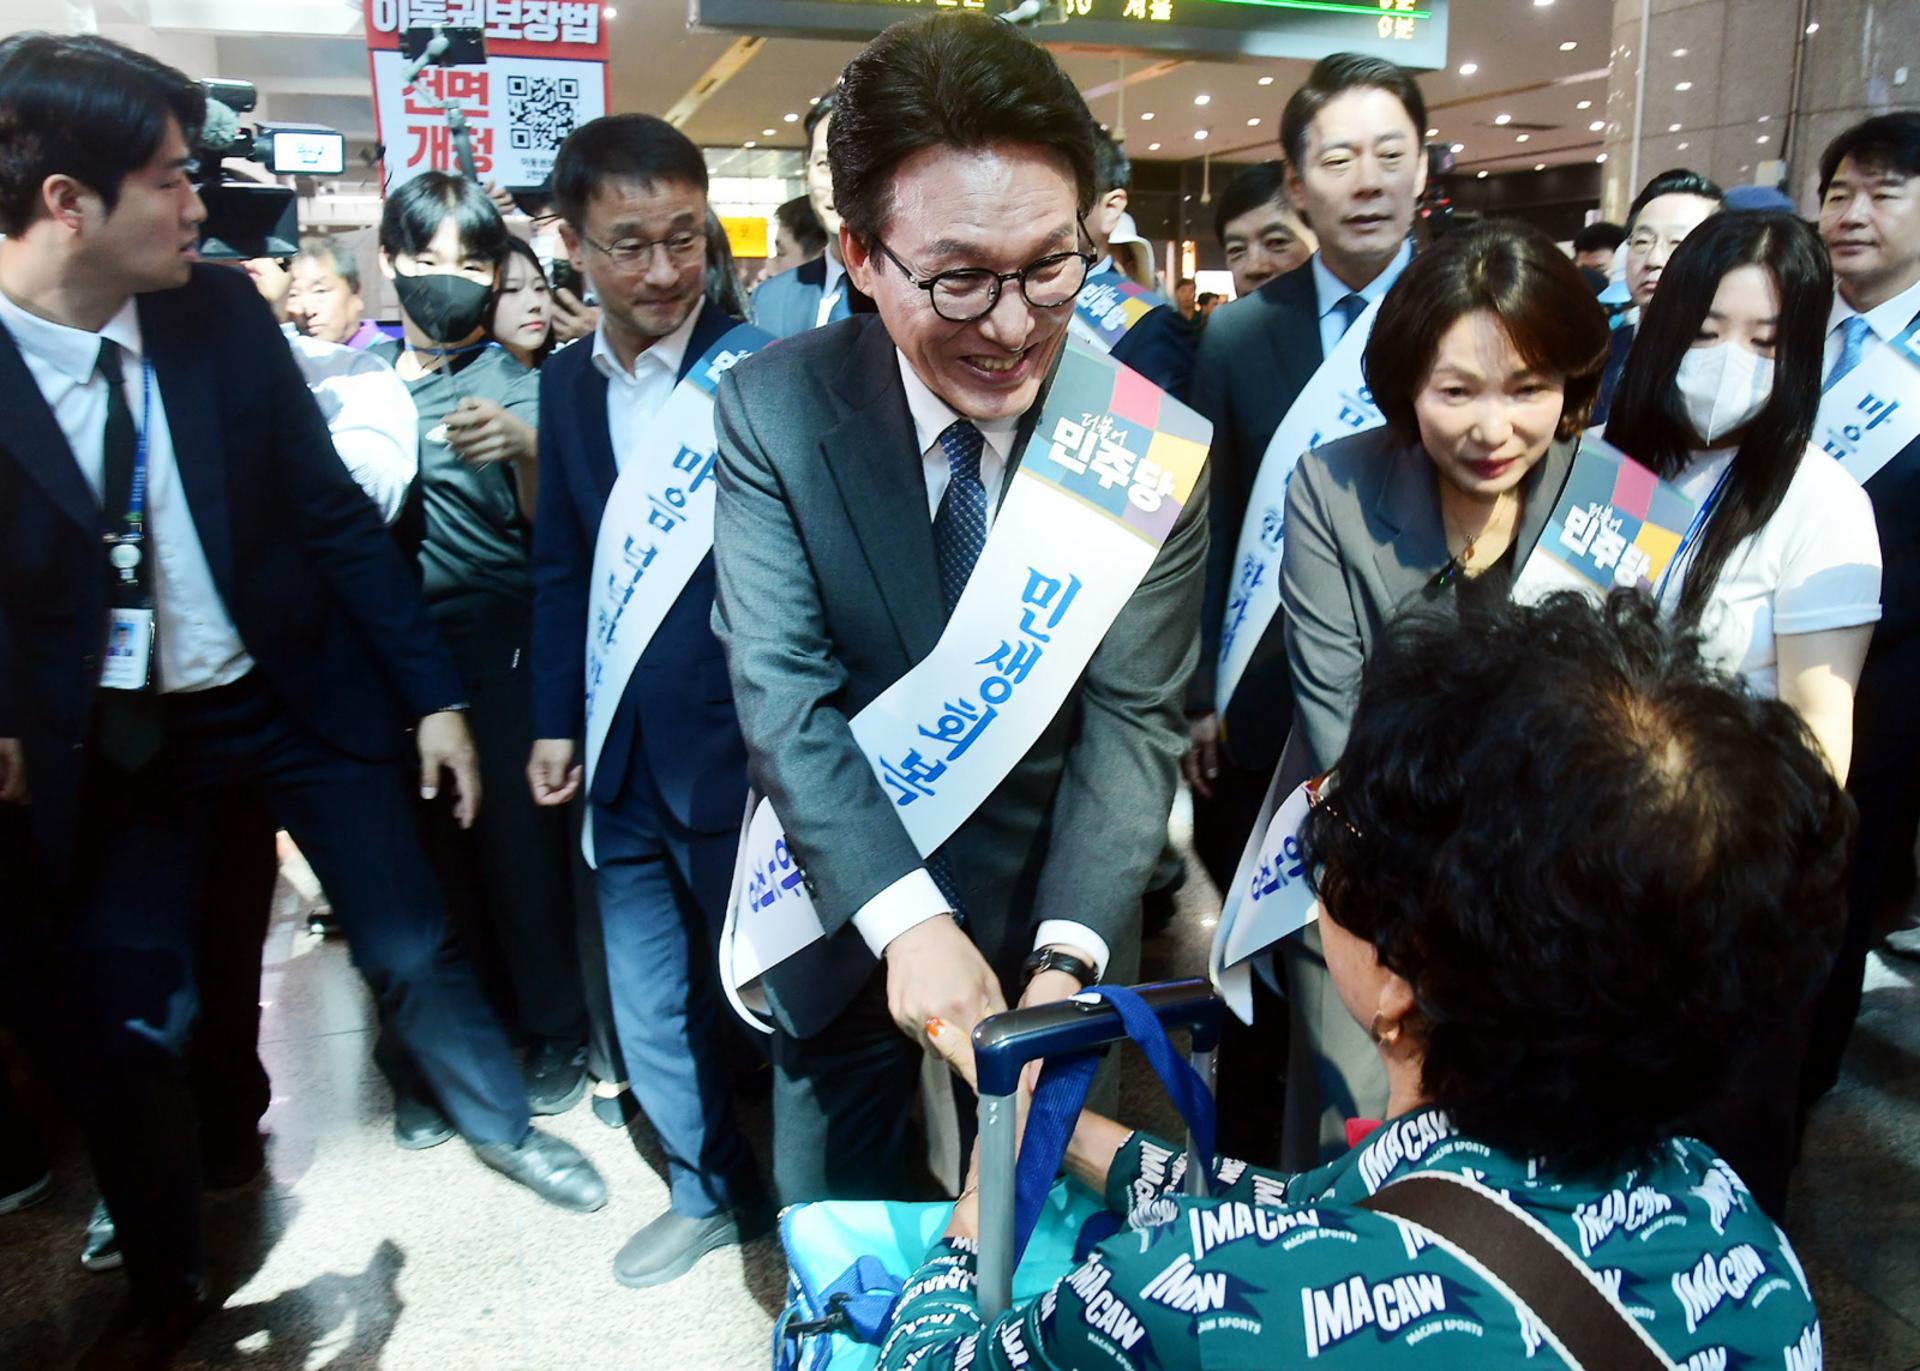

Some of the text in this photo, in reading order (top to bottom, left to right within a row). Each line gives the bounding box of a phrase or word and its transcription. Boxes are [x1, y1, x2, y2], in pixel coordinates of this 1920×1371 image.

[402, 70, 489, 117] 전면
[1048, 417, 1176, 512] 민주당
[1560, 504, 1652, 588] 민주당
[1443, 1318, 1484, 1338] SPORTS
